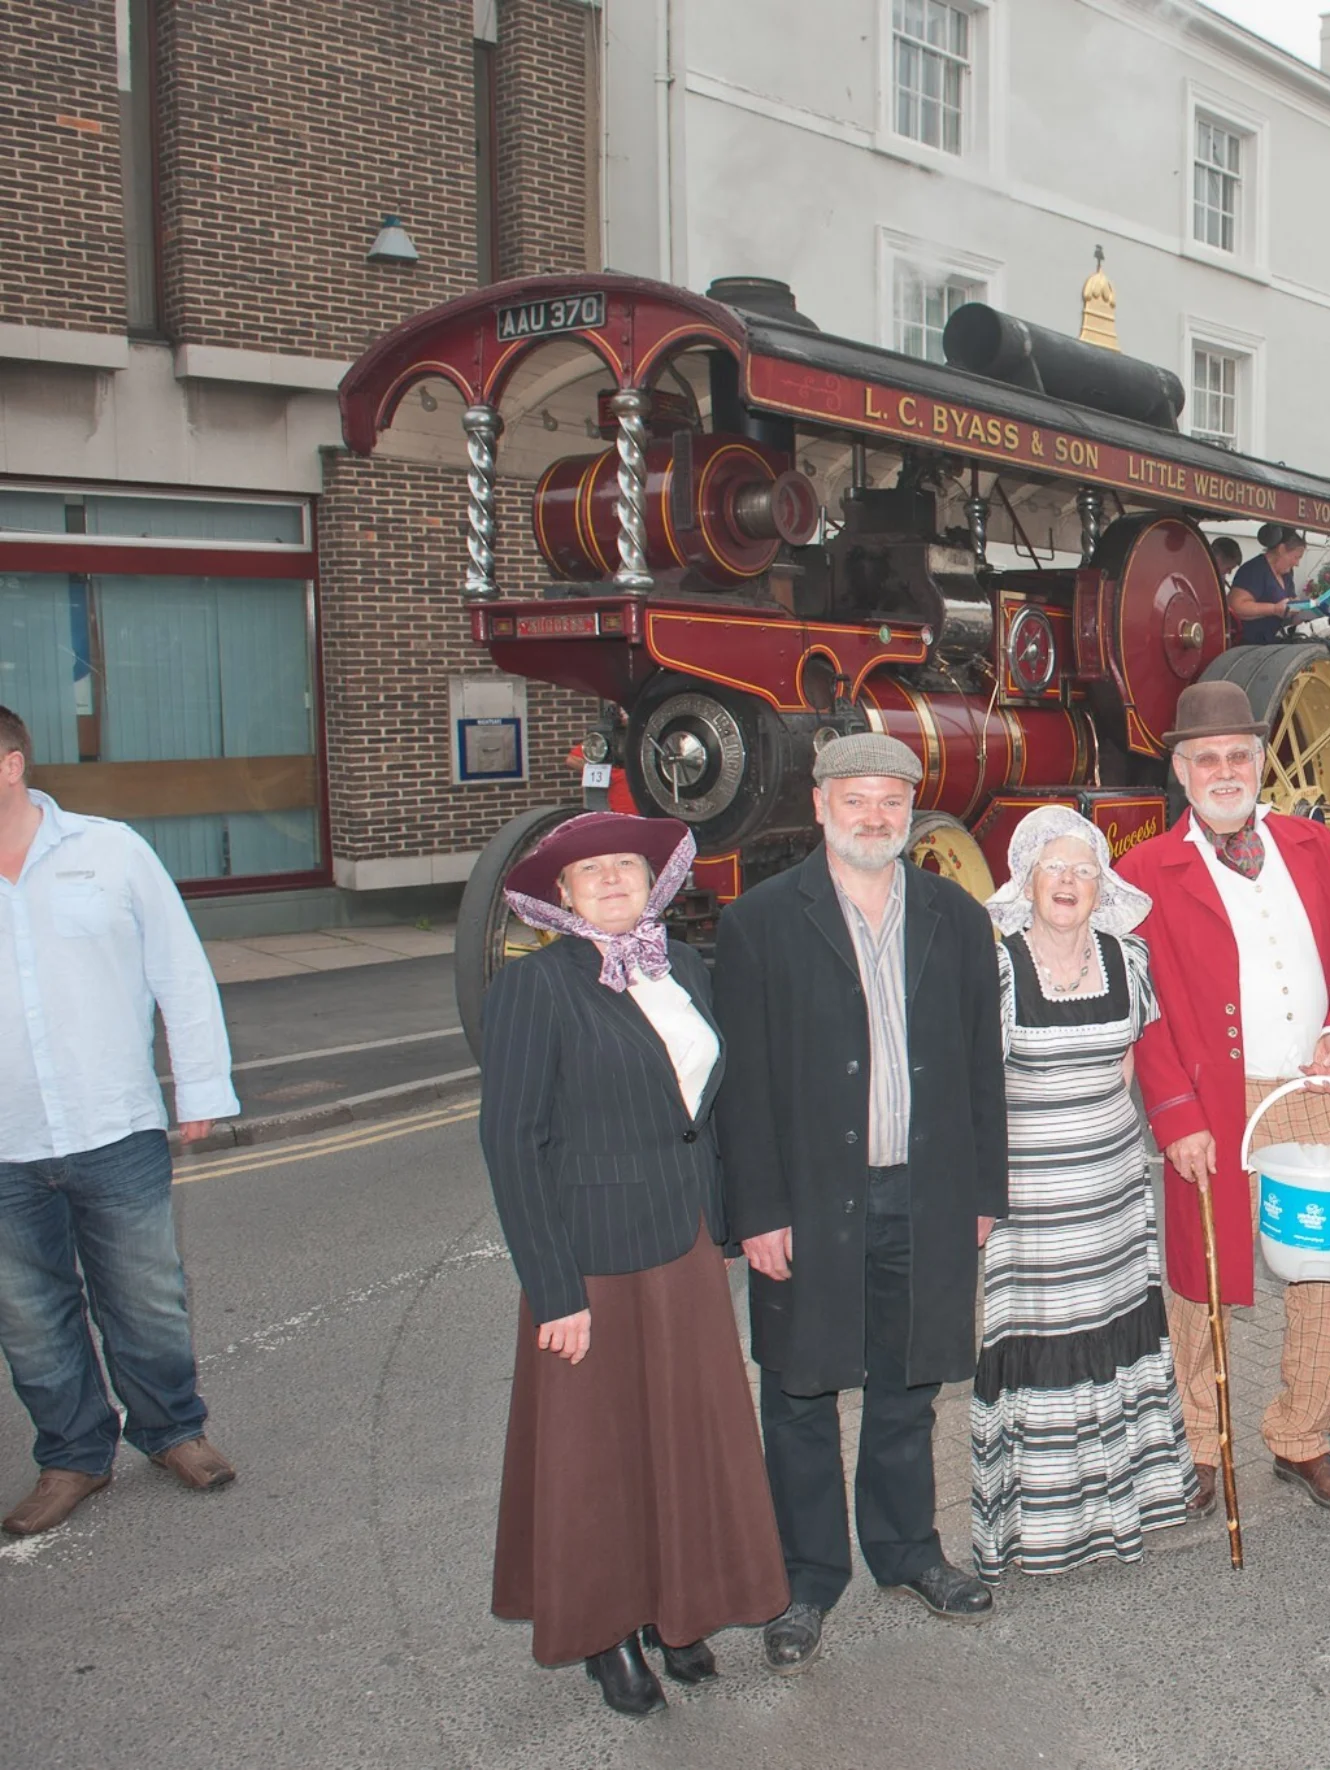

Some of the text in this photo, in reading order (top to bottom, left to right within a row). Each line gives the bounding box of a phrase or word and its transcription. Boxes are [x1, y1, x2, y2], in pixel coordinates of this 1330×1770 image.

[502, 296, 598, 337] AAU 370
[864, 386, 1100, 470] L. C. BYASS & SON
[1127, 454, 1277, 511] LITTLE WEIGHTON
[590, 770, 603, 784] 13
[1107, 816, 1157, 859] Success
